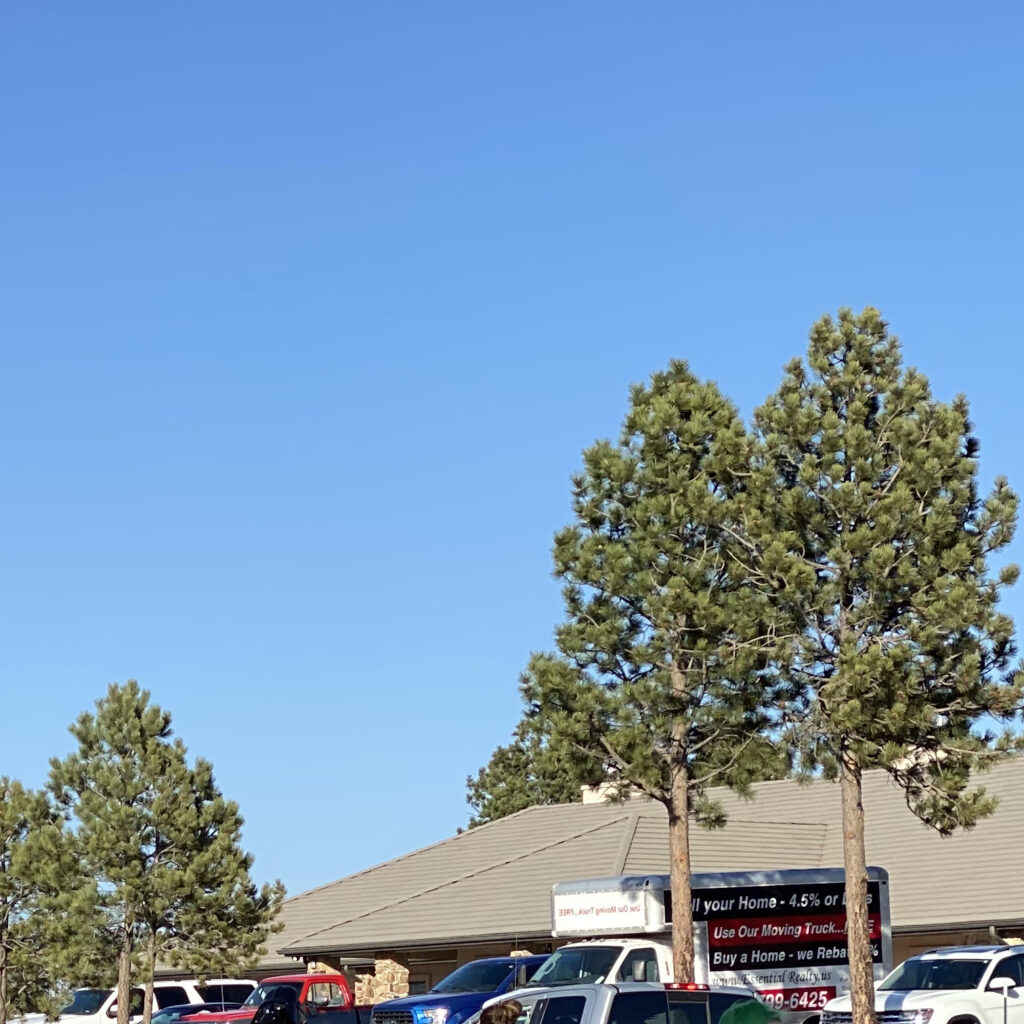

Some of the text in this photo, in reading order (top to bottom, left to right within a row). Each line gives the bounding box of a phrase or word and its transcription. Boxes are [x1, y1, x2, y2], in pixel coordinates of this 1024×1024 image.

[704, 899, 735, 915] your
[738, 895, 777, 910] Home
[789, 893, 820, 908] 4.5%
[824, 894, 839, 906] or
[713, 926, 735, 939] Use
[738, 925, 759, 938] Our
[761, 923, 802, 938] Moving
[713, 951, 737, 967] Buy
[740, 953, 748, 963] a
[751, 949, 786, 963] Home
[797, 949, 814, 960] we
[817, 946, 849, 960] Reba
